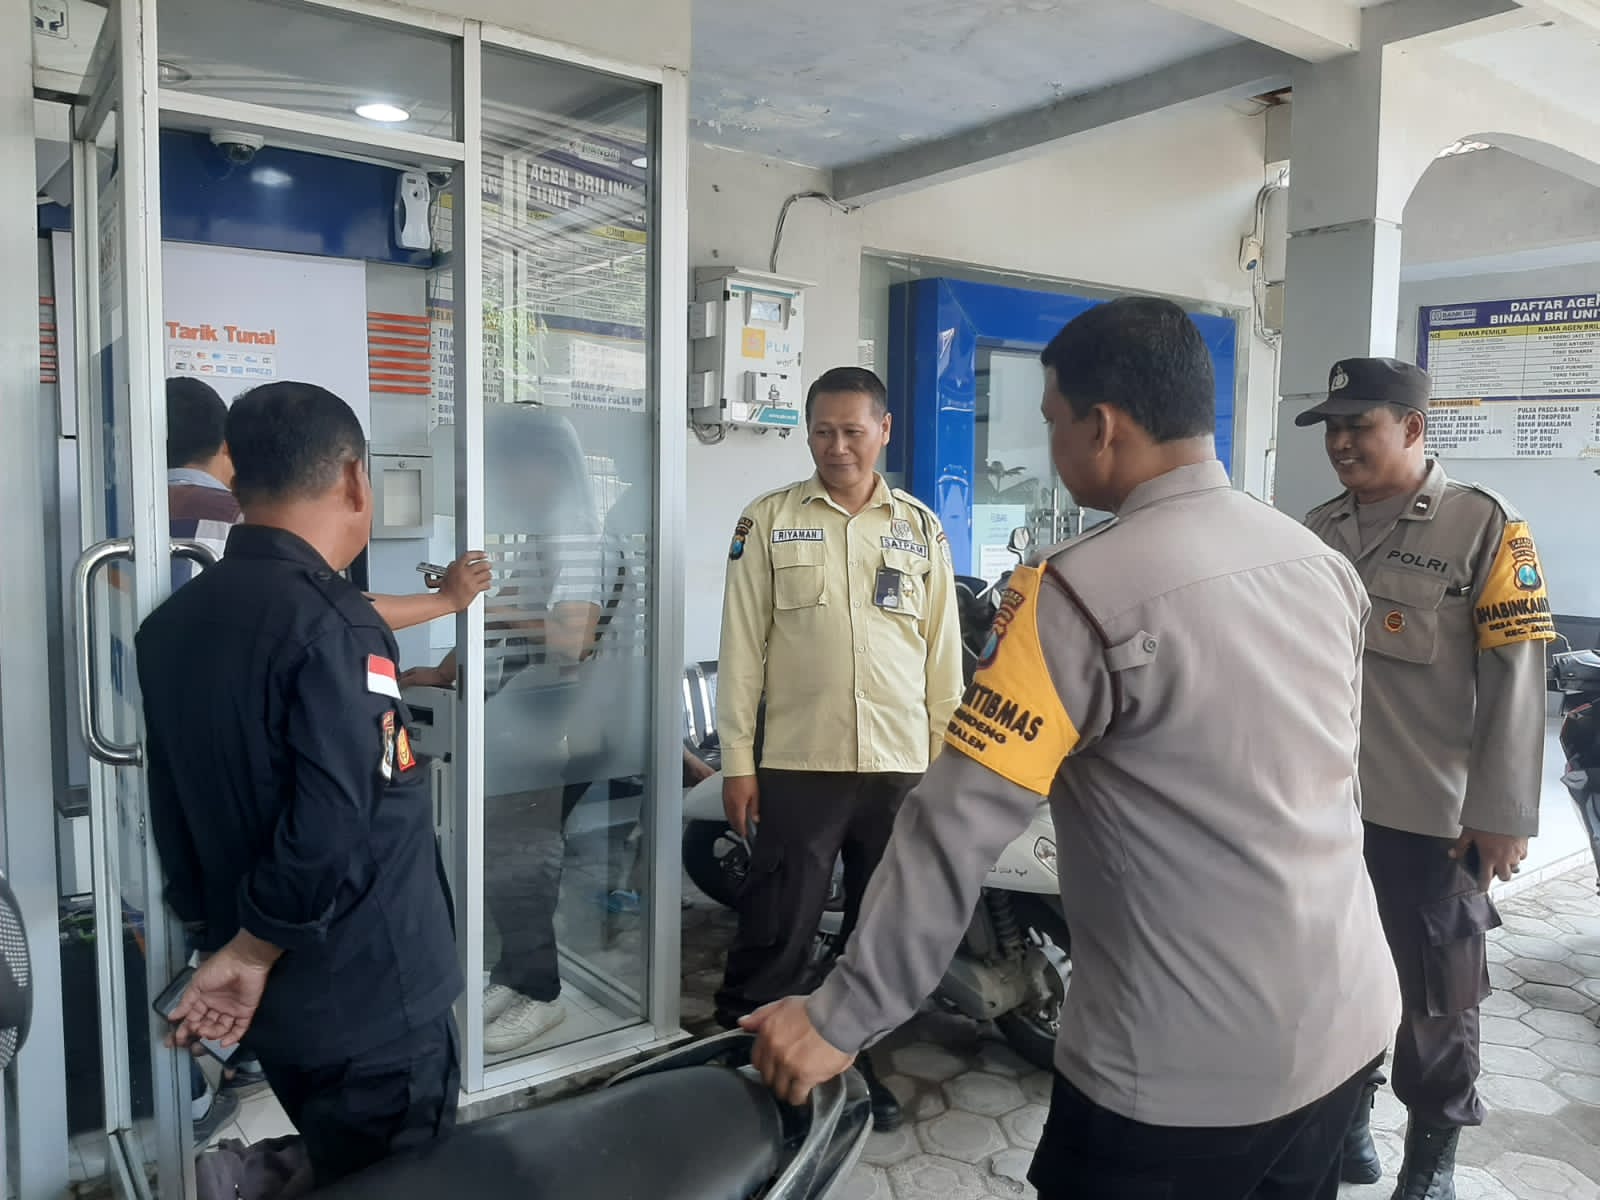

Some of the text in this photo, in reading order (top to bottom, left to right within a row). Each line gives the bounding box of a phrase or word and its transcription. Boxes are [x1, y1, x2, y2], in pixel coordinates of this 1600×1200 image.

[530, 164, 569, 188] AGEN
[1511, 300, 1562, 312] DAFTAR
[1490, 313, 1540, 324] BINAAN
[1544, 311, 1568, 321] BRI
[166, 321, 276, 345] Tarik Tunai
[778, 530, 817, 540] RIYAMAN
[883, 538, 923, 553] SATPAM
[1386, 550, 1448, 573] POLRI
[1488, 620, 1513, 632] DESA
